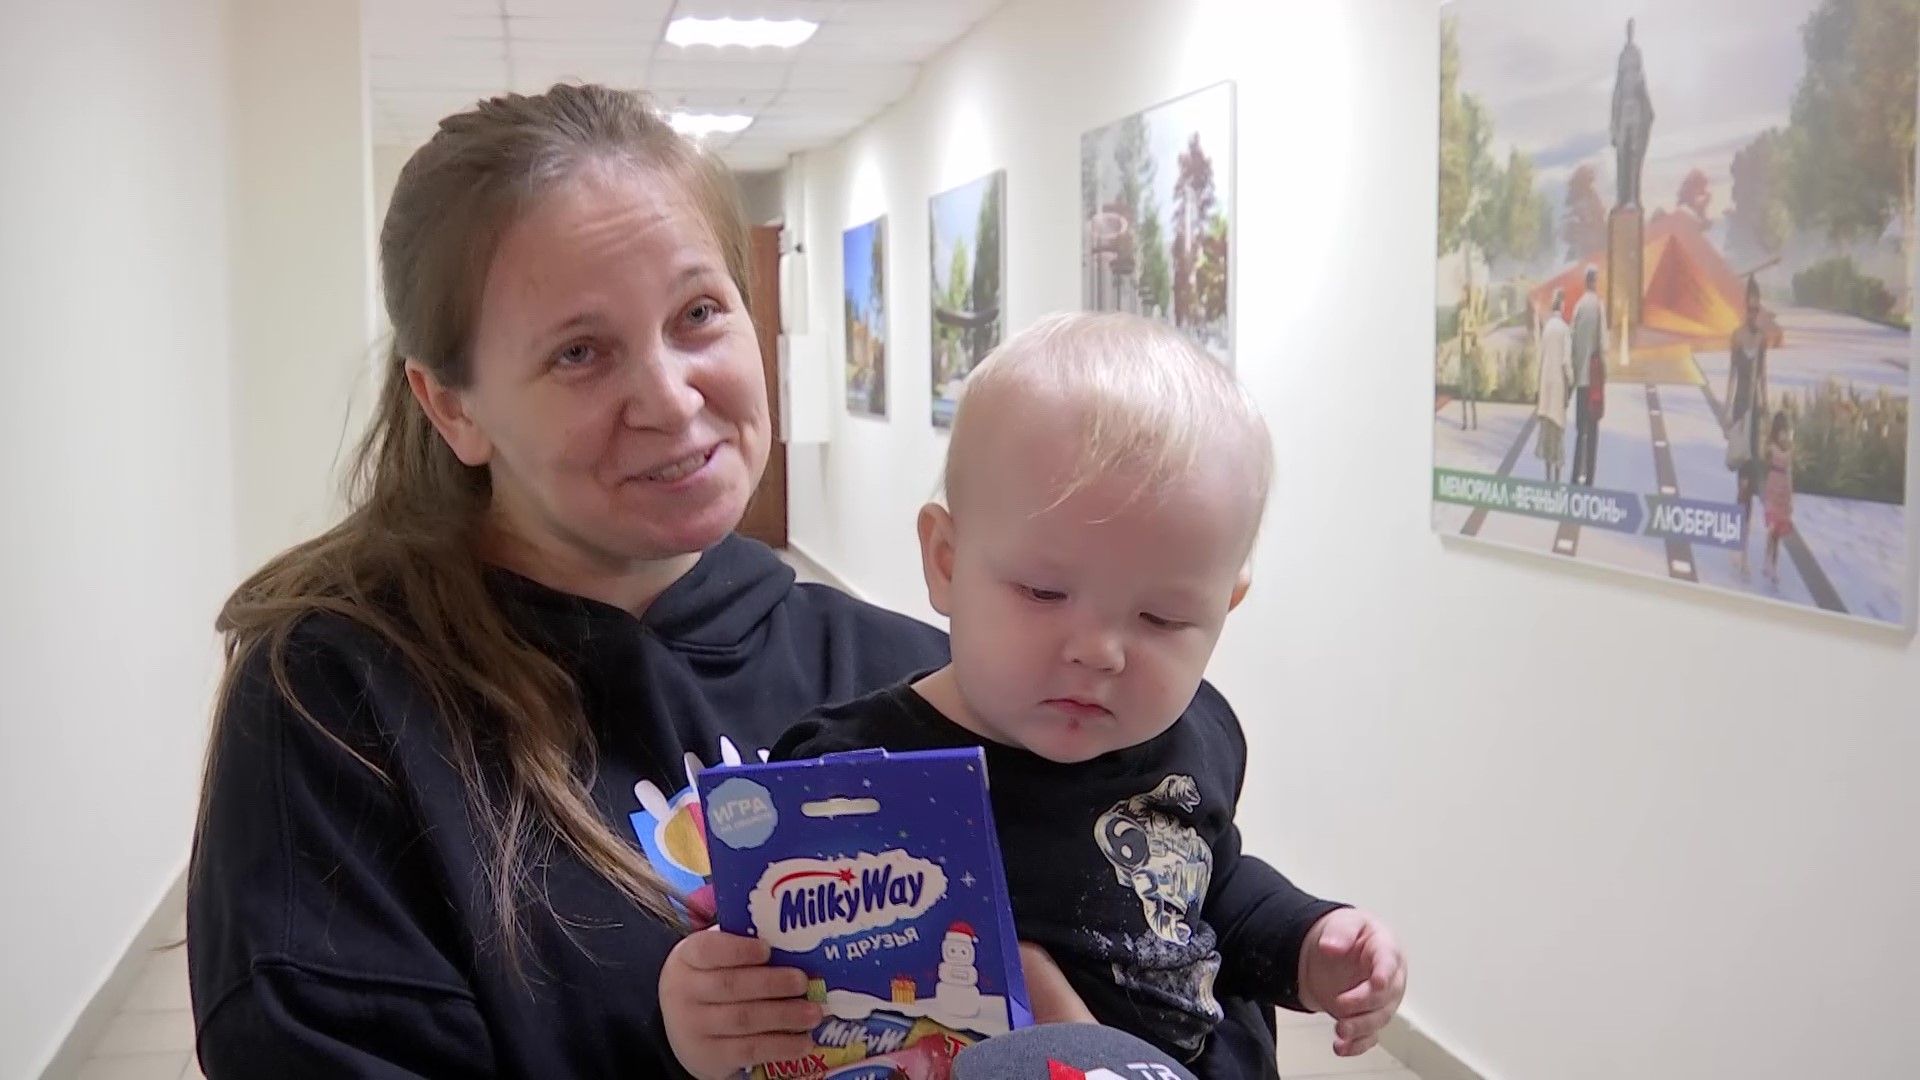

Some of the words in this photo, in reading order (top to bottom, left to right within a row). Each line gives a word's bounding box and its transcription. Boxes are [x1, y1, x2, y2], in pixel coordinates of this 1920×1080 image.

[1438, 474, 1509, 507] МЕМОРИАЛ
[1652, 503, 1742, 543] ЛЮБЕРЦЫ
[712, 798, 769, 825] ИГРА
[824, 943, 841, 961] И
[845, 926, 920, 961] ДРУЗЬЯ
